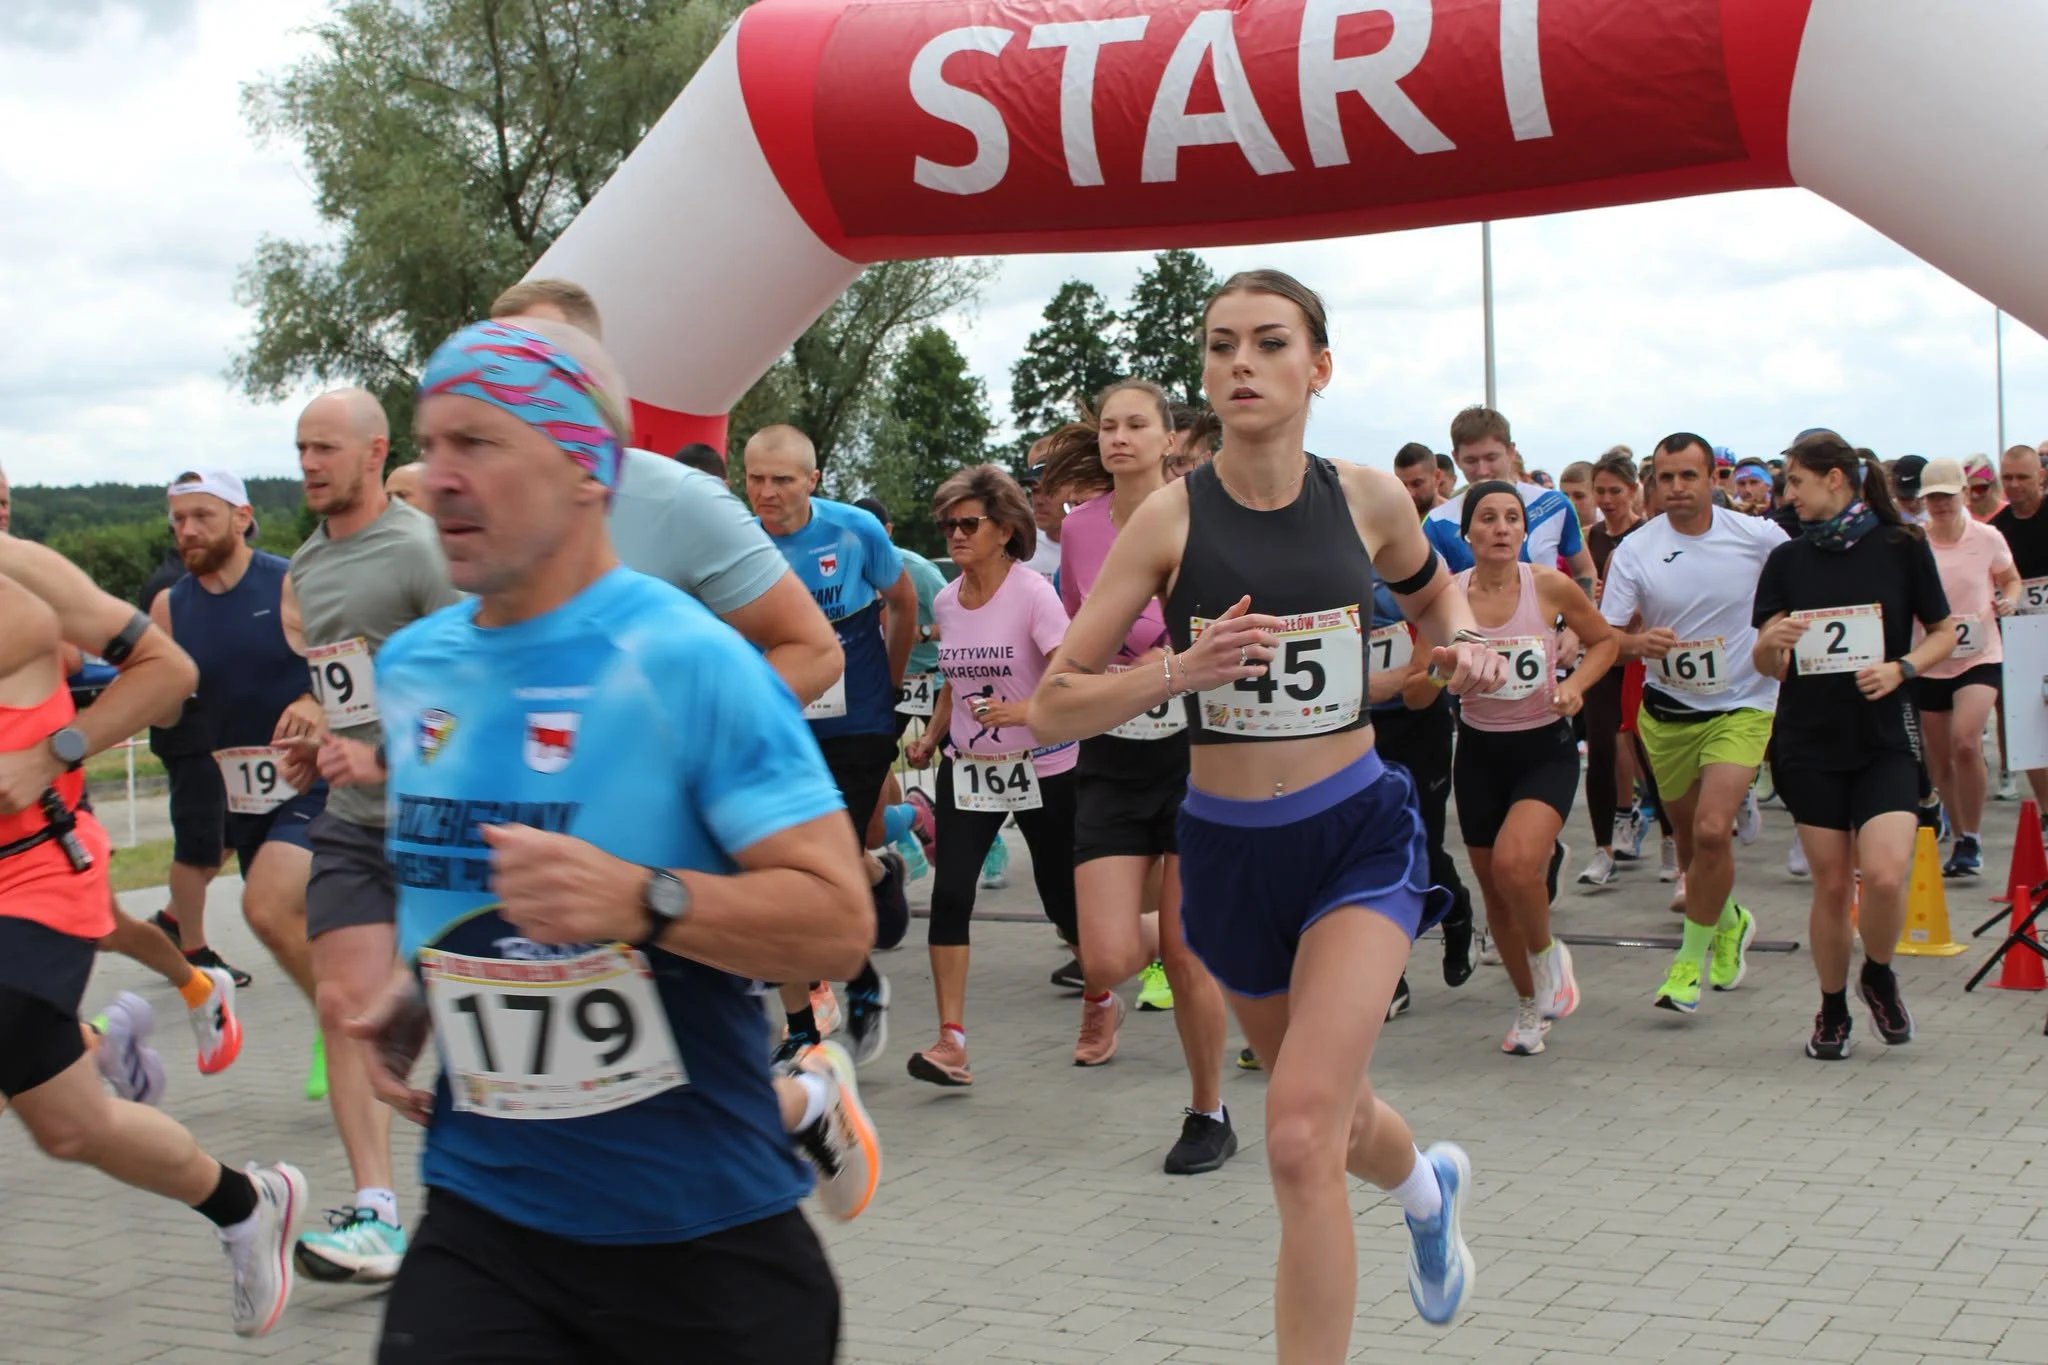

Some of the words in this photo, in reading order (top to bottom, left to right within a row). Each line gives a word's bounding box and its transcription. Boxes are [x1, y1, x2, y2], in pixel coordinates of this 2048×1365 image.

[1824, 621, 1849, 654] 2
[1955, 624, 1971, 646] 2
[1234, 638, 1326, 703] 45
[1661, 651, 1716, 679] 161
[239, 761, 277, 795] 19
[963, 763, 1031, 795] 164
[455, 988, 635, 1075] 179
